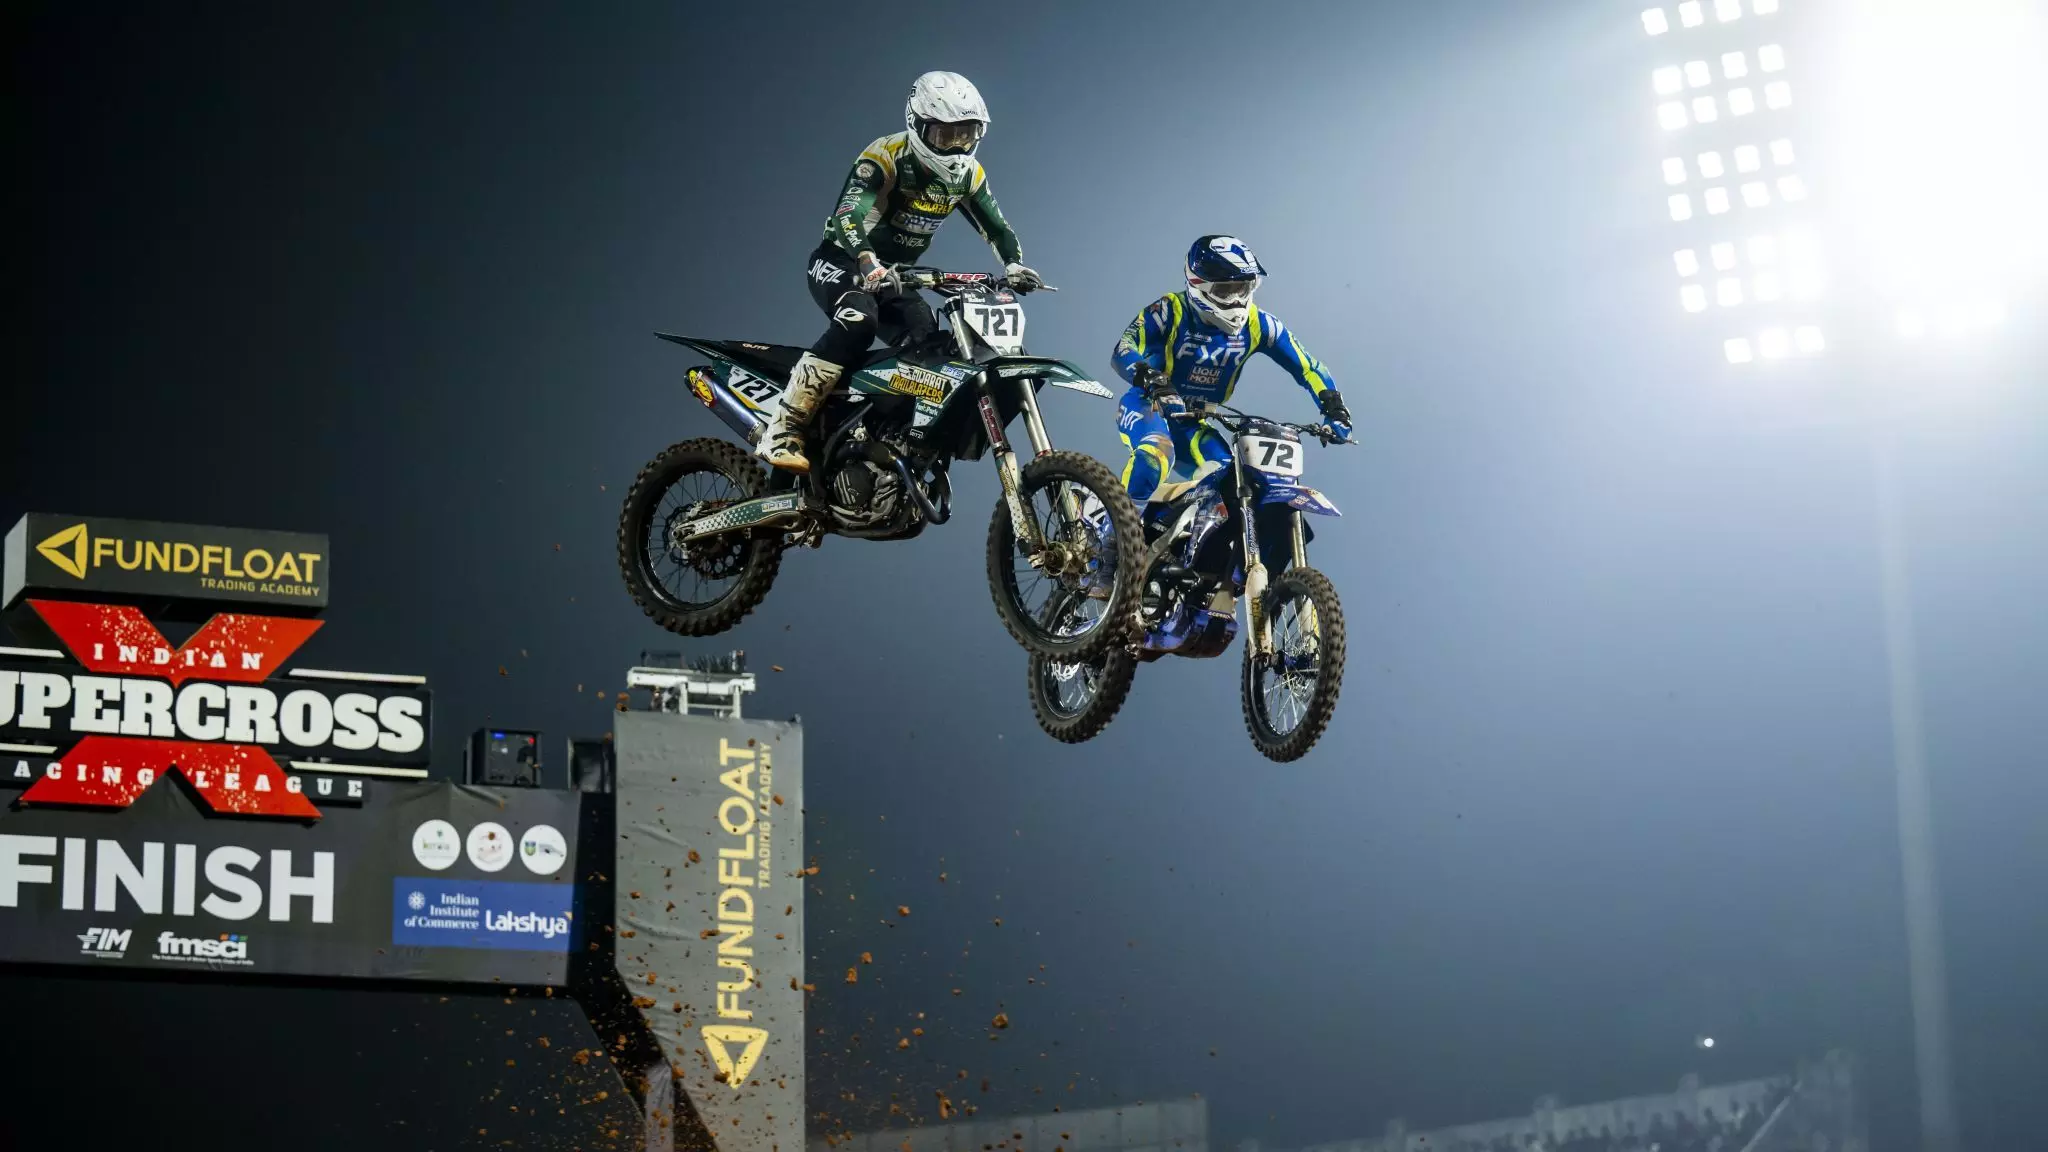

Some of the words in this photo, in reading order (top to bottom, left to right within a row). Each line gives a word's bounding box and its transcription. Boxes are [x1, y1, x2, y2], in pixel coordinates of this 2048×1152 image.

[975, 308, 1018, 337] 727
[1176, 341, 1246, 368] FXR
[911, 368, 948, 391] GUJARAT
[1189, 373, 1220, 385] MOLY
[1192, 366, 1222, 377] LIQUI
[732, 373, 780, 404] 727
[889, 374, 944, 404] TRAILBLAZERS
[1259, 440, 1294, 470] 72
[94, 537, 321, 583] FUNDFLOAT
[201, 578, 256, 593] TRADING
[260, 583, 320, 597] ACADEMY
[94, 643, 264, 670] INDIAN
[195, 768, 363, 798] LEAGUE
[759, 742, 773, 817] ACADEMY
[758, 820, 773, 889] TRADING
[0, 833, 335, 924] FINISH
[717, 737, 756, 1019] FUNDFLOAT
[430, 905, 480, 918] Institute
[441, 893, 480, 906] Indian
[404, 916, 417, 927] of
[417, 917, 480, 930] Commerce
[485, 909, 569, 939] Lakshya
[77, 927, 132, 951] FIM
[157, 930, 248, 959] fmsci
